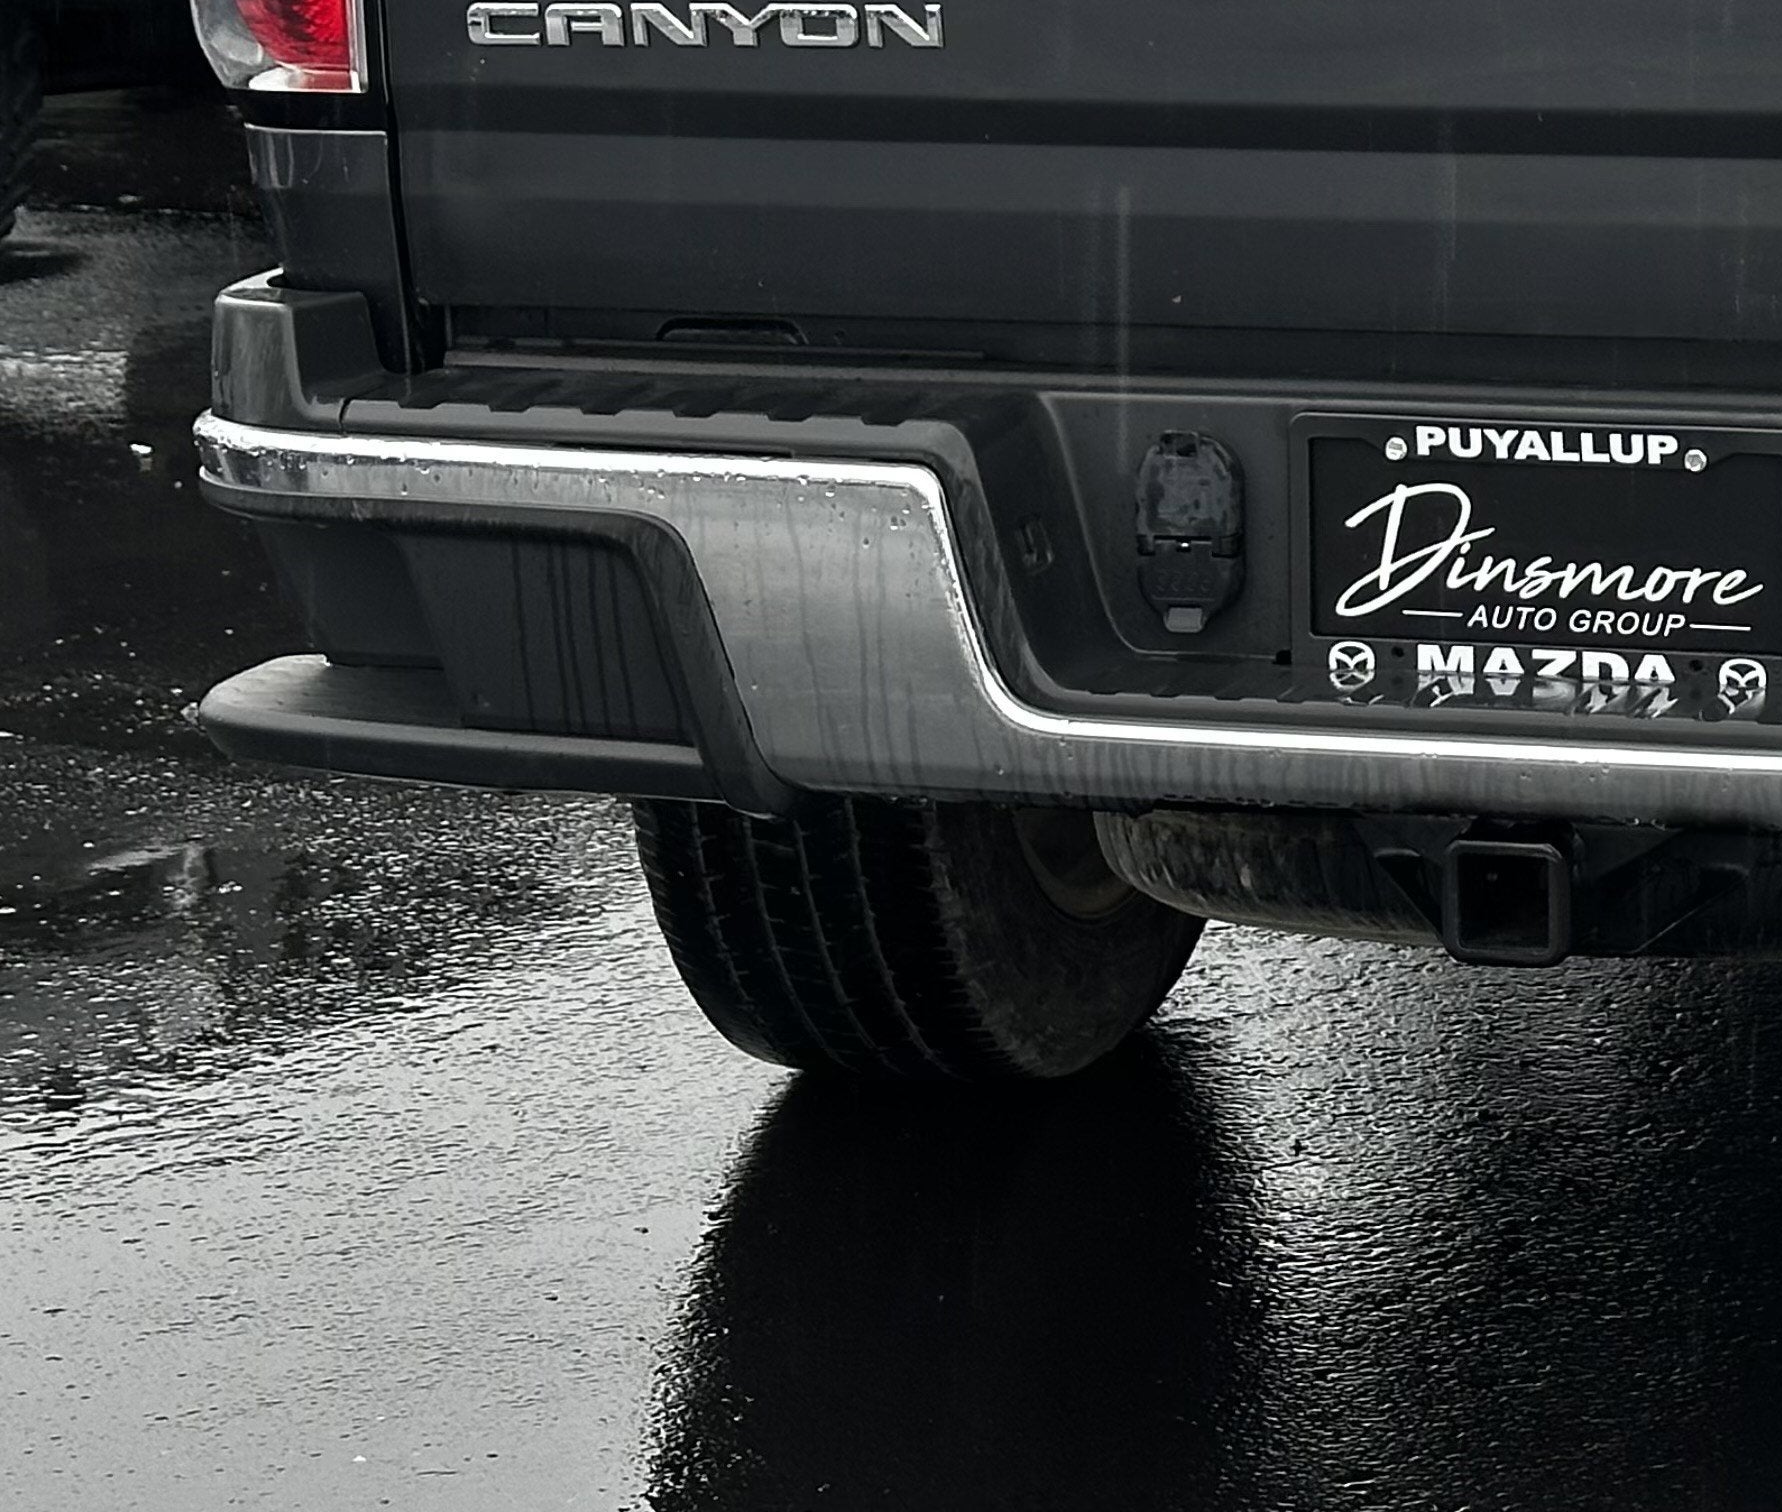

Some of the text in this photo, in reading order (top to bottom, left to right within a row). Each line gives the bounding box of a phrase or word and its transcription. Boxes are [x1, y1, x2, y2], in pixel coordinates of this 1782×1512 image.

[467, 1, 943, 48] CANYON
[1417, 426, 1678, 464] PUYALLUP
[1336, 483, 1763, 617] Dinsmore
[1467, 604, 1686, 636] AUTO GROUP
[1417, 644, 1675, 682] MAZDA
